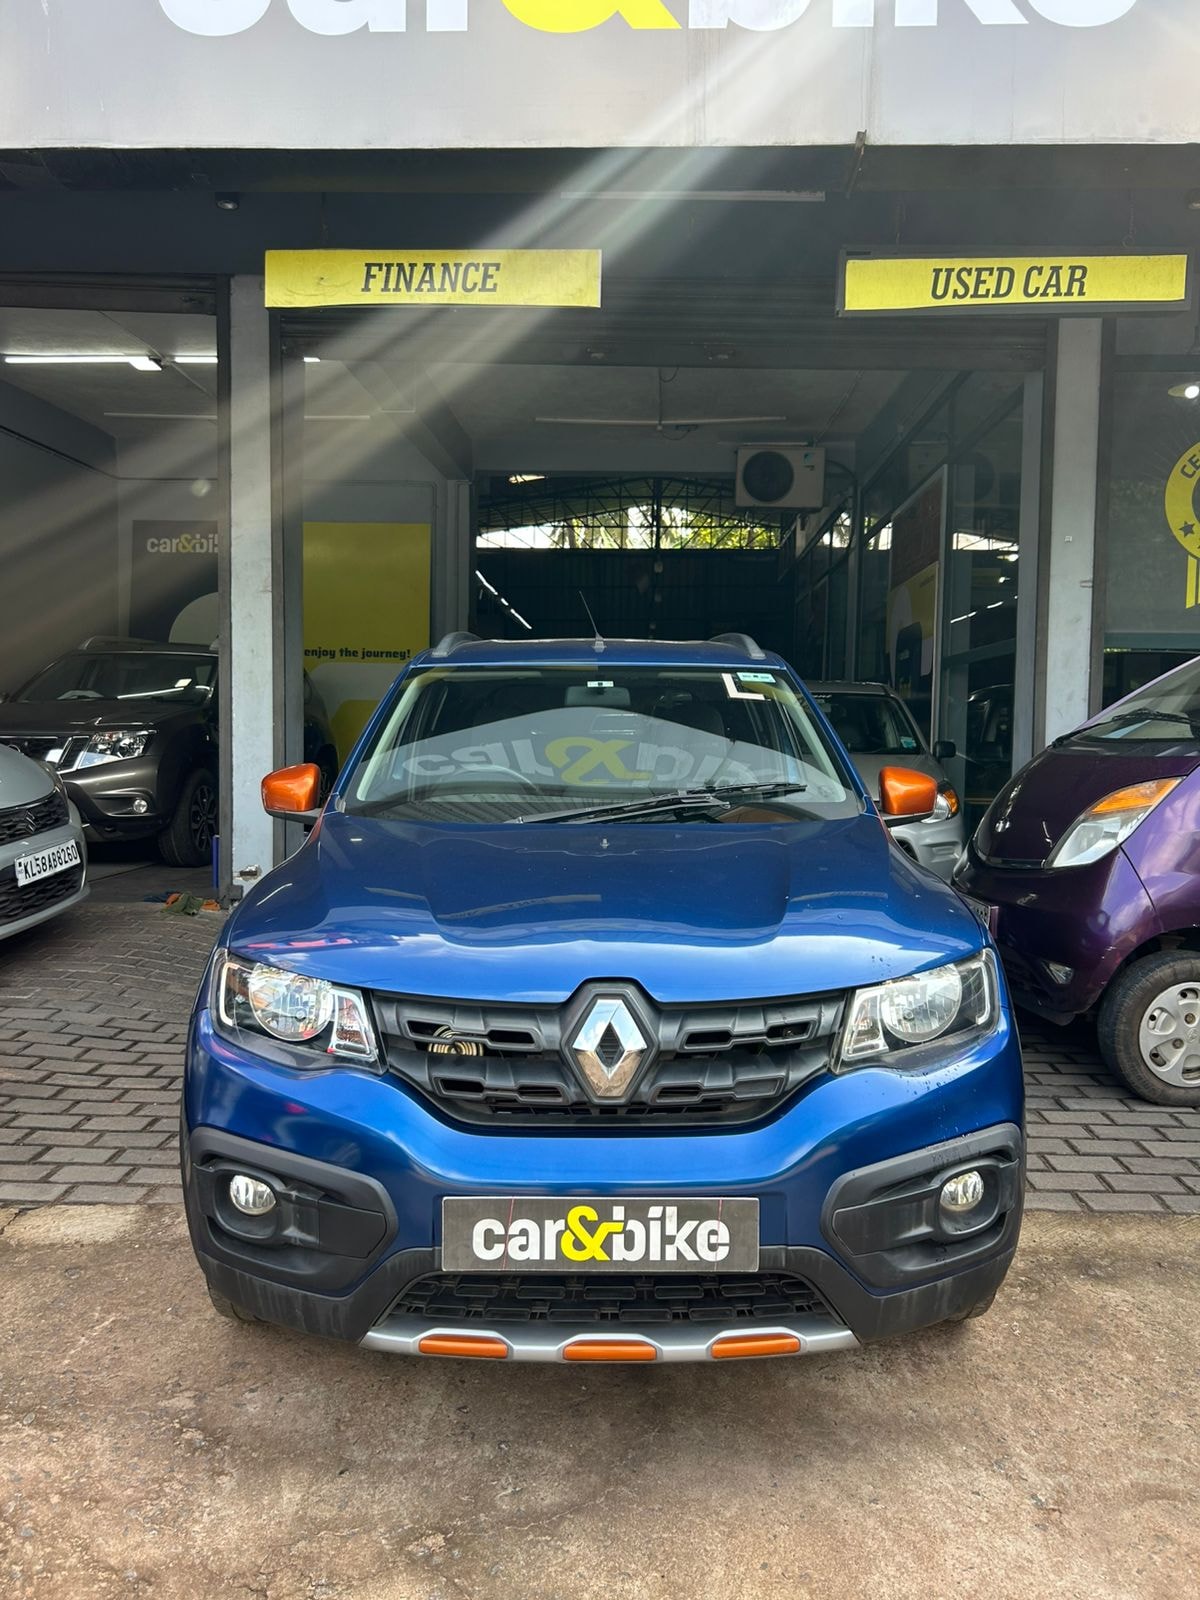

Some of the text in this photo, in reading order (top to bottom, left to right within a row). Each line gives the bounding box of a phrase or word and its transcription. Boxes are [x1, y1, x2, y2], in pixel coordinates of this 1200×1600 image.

[361, 262, 501, 293] FINANCE
[931, 265, 1088, 300] USED CAR
[1180, 453, 1200, 479] CE
[304, 647, 411, 660] enjoy the journey!
[472, 1205, 730, 1262] car&bike
